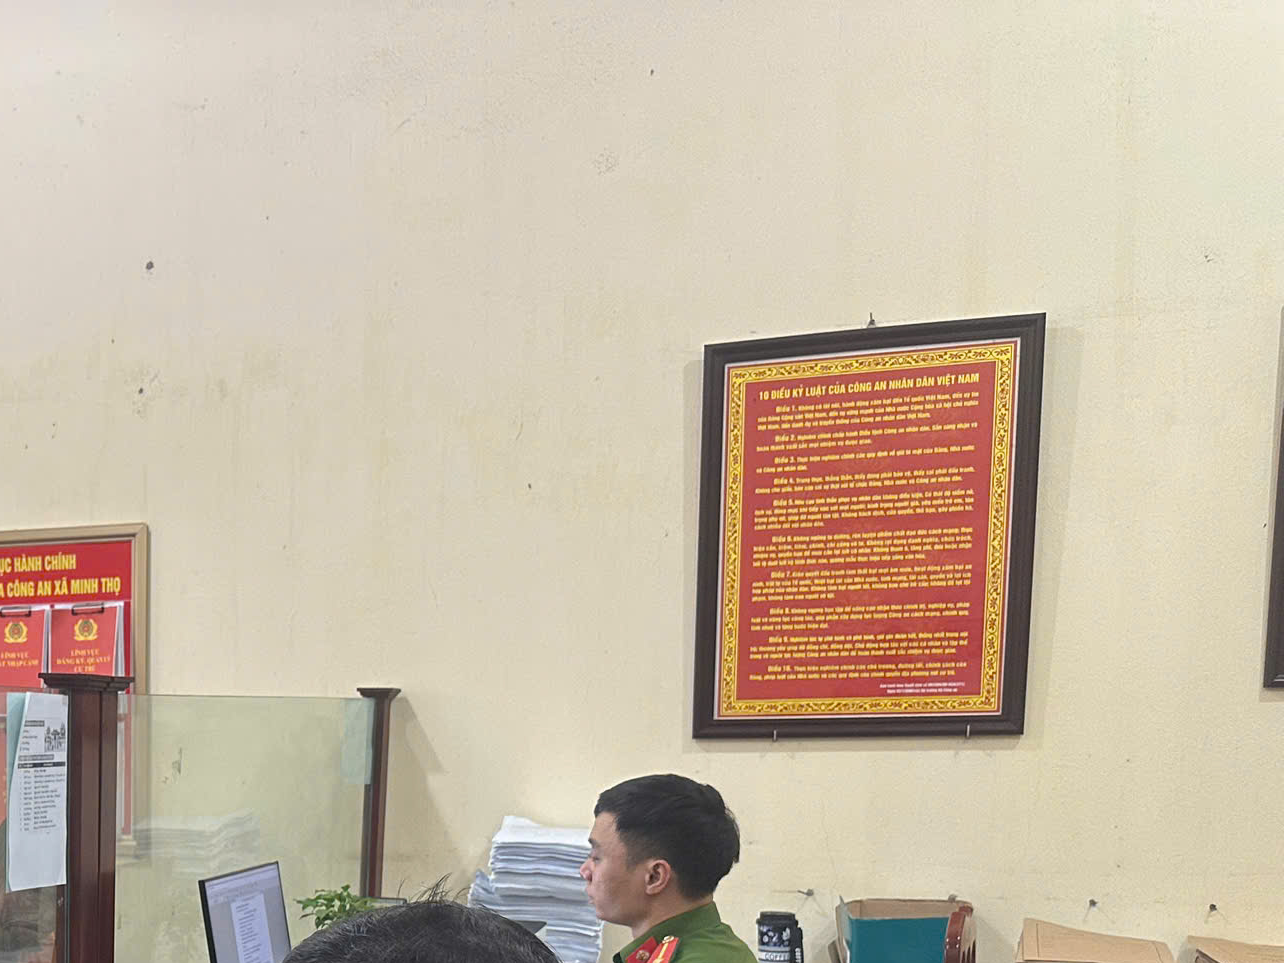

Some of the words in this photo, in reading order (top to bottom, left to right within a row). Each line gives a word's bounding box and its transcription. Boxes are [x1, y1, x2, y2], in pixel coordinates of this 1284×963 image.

[759, 391, 769, 400] 10
[771, 387, 790, 400] ĐIỀU
[806, 384, 826, 398] LUẬT
[828, 382, 846, 394] CỦA
[848, 382, 872, 393] CÔNG
[874, 380, 886, 391] AN
[889, 377, 914, 390] NHÂN
[916, 376, 934, 388] DÂN
[937, 374, 956, 387] VIỆT
[958, 373, 980, 384] NAM
[14, 554, 42, 572] HÀNH
[44, 552, 76, 570] CHÍNH
[7, 579, 34, 598] CÔNG
[37, 580, 52, 596] AN
[54, 578, 68, 595] XÃ
[70, 578, 98, 594] MINH
[101, 576, 121, 596] THỌ
